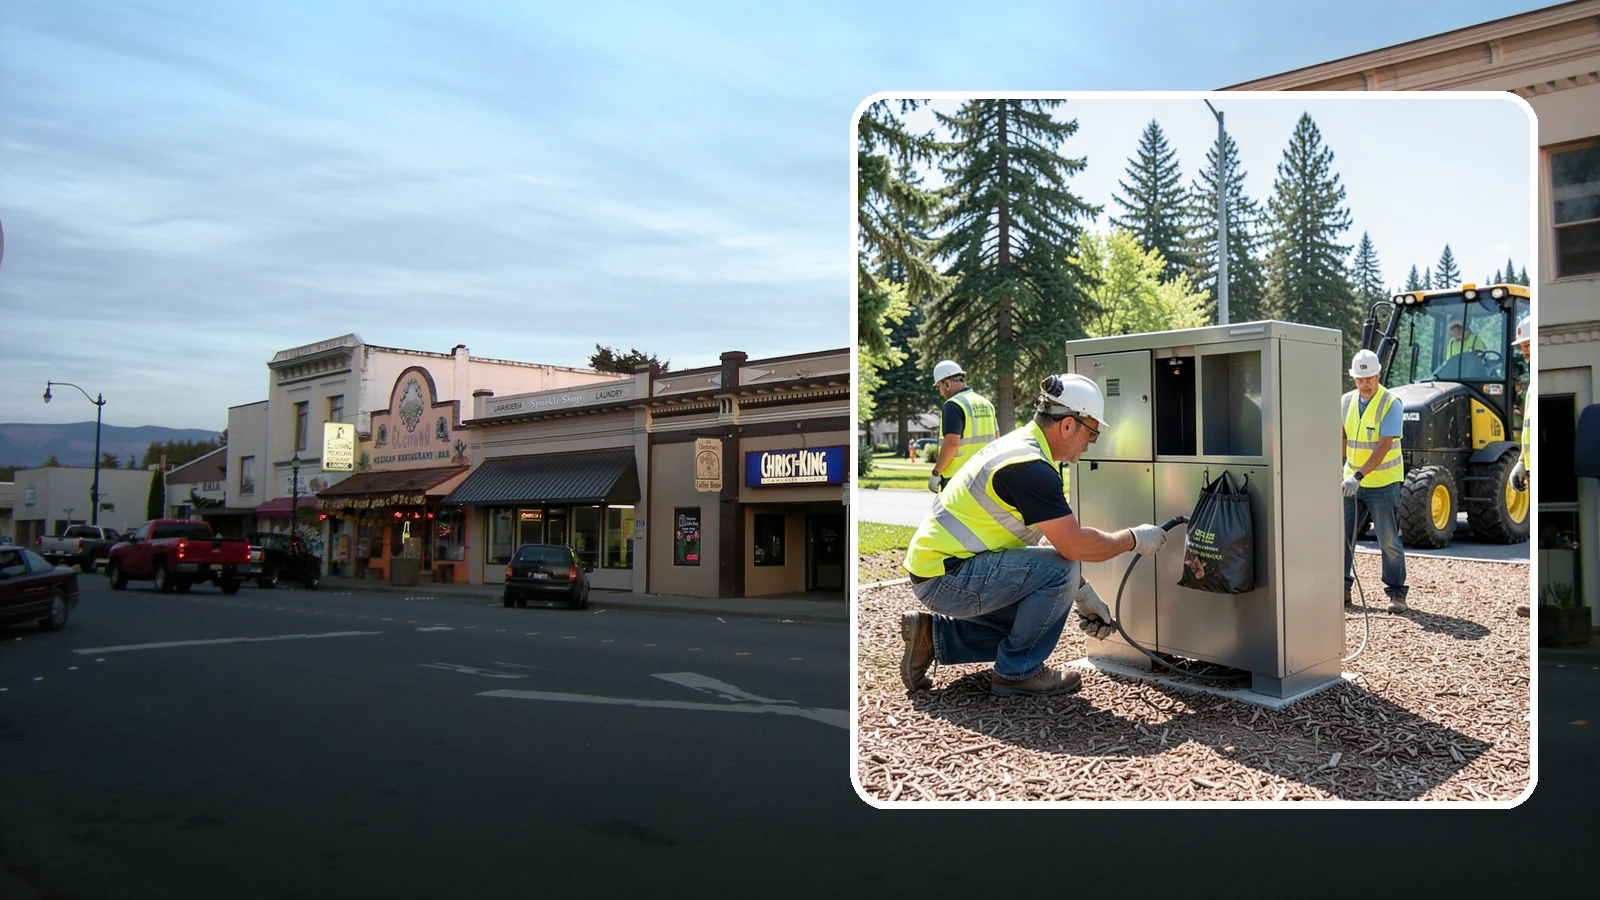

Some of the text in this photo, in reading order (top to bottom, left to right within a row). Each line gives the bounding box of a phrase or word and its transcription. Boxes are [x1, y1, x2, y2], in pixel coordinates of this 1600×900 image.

[494, 389, 623, 412] LAVANDERIA Sparkle Shop LAUNDRY
[374, 455, 396, 464] MEXICAN
[397, 451, 433, 462] RESTAURANT
[437, 450, 450, 458] BAR
[761, 450, 827, 478] CHRIST KING
